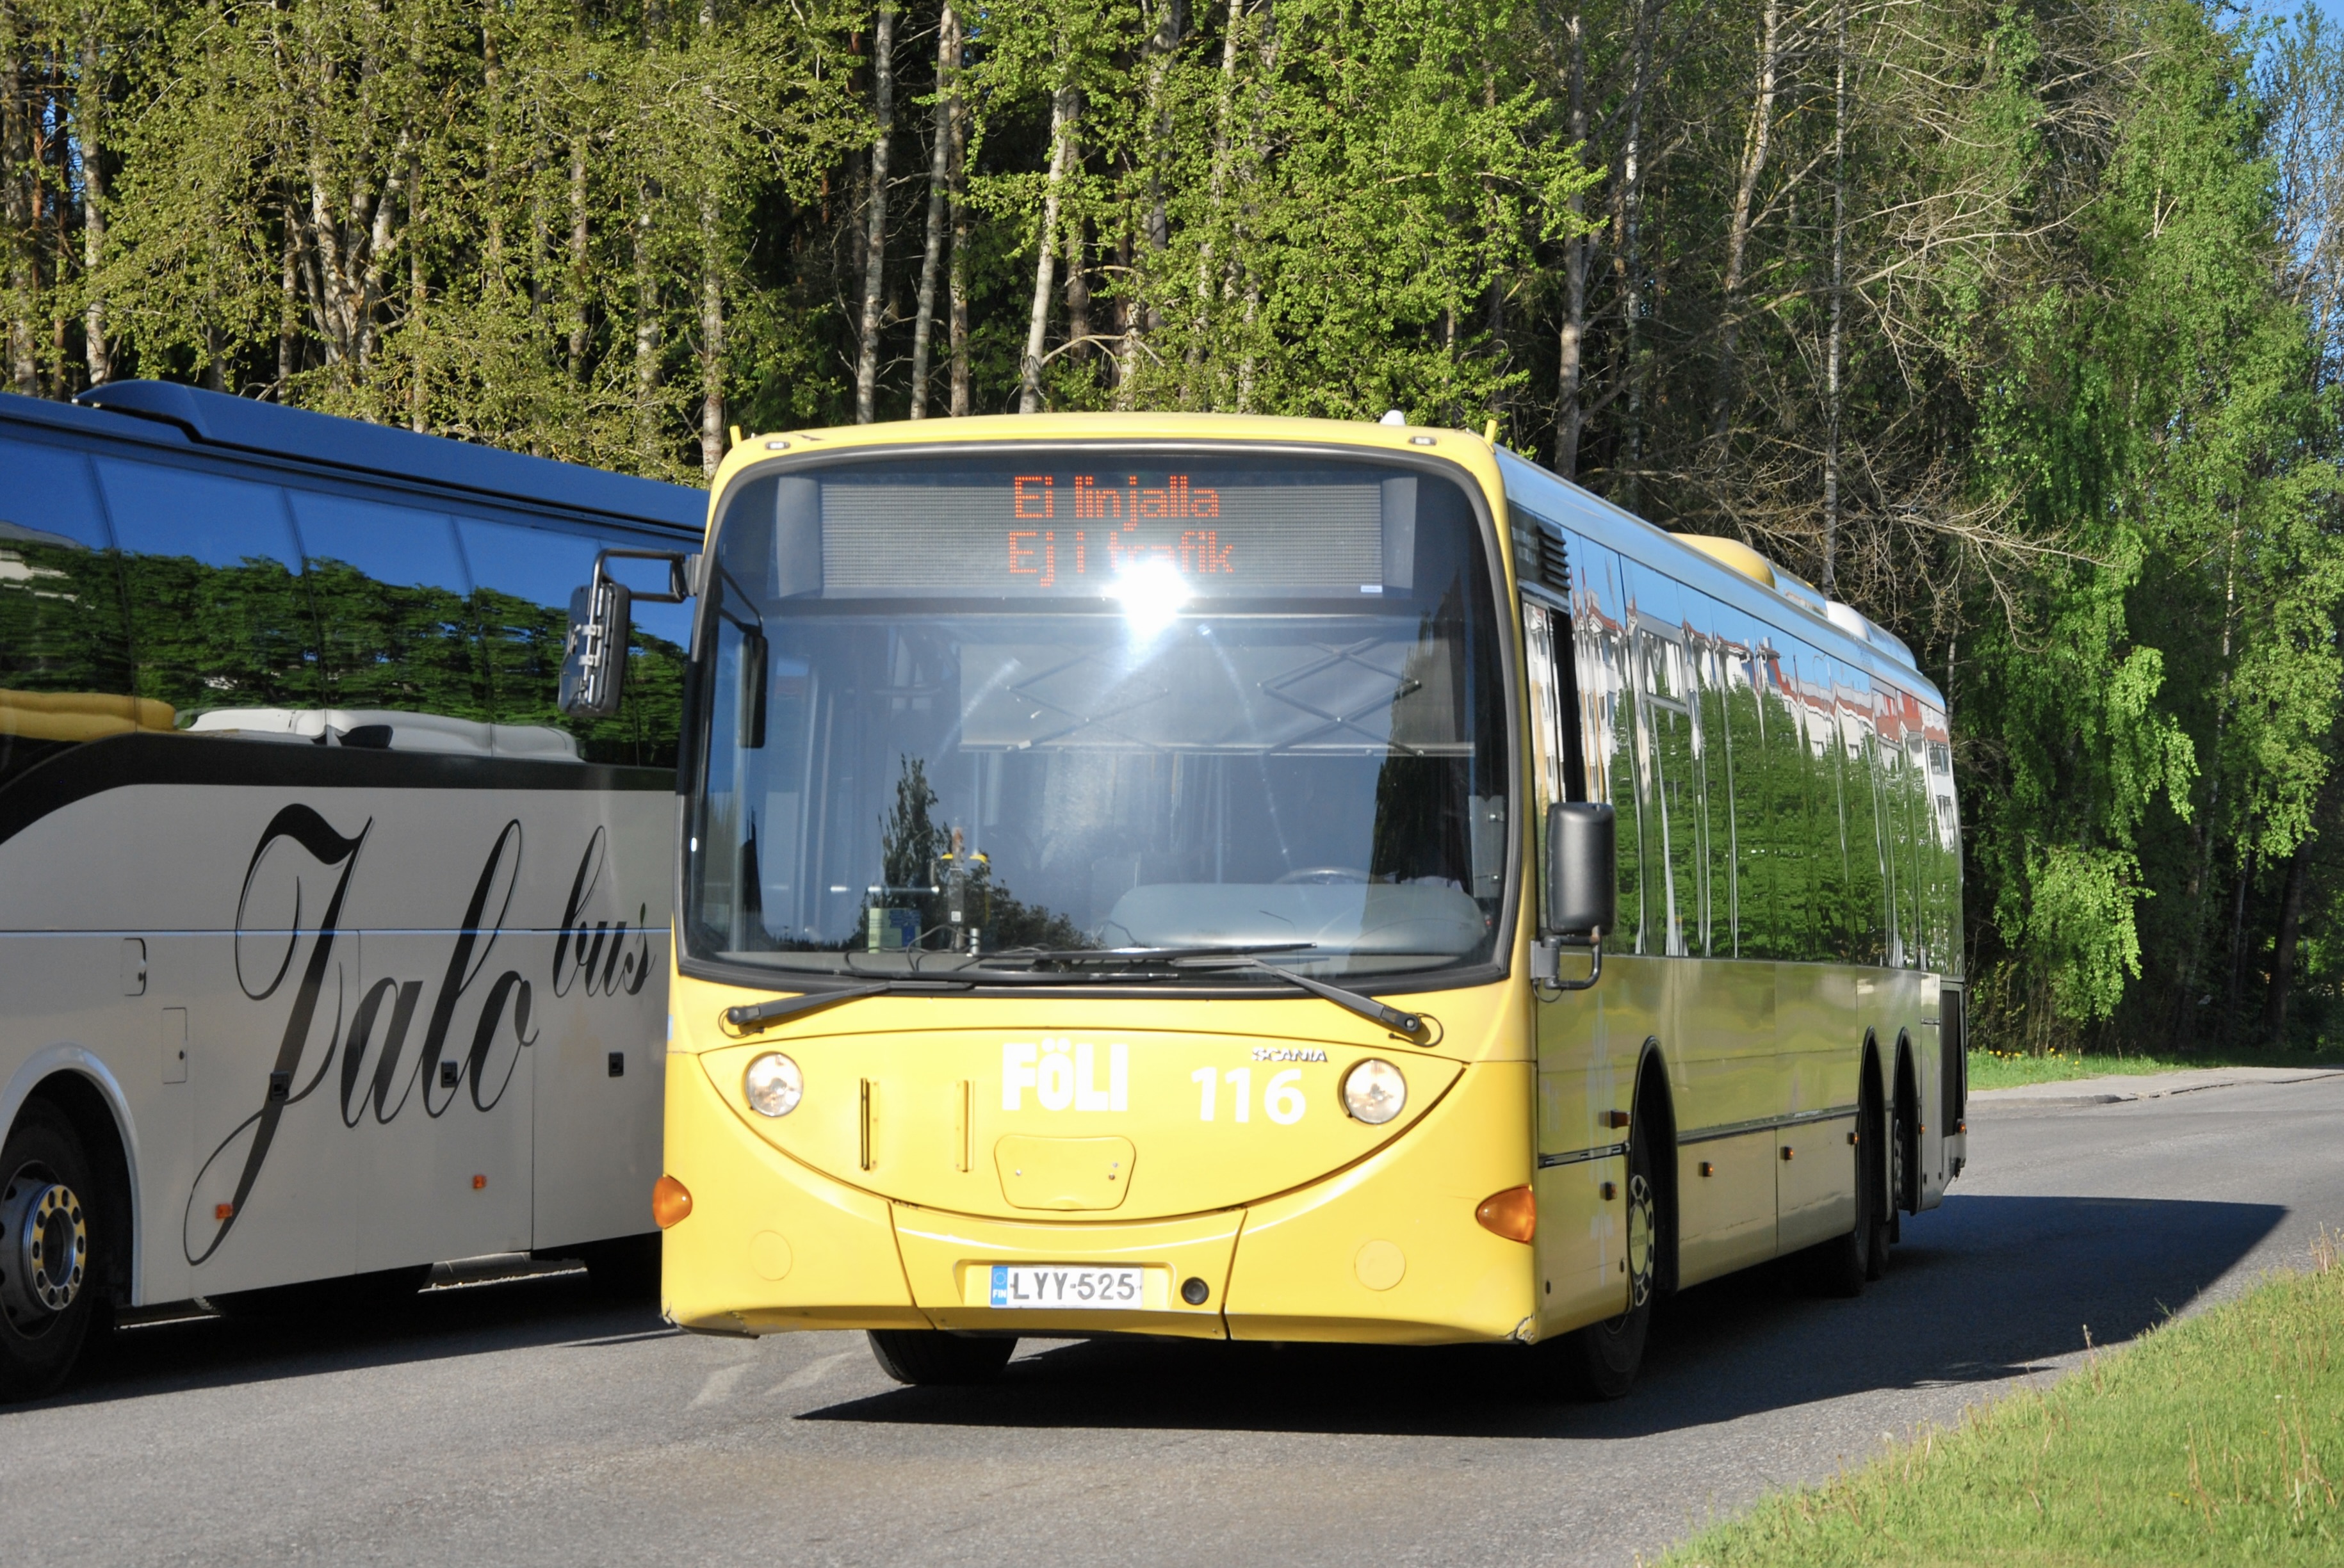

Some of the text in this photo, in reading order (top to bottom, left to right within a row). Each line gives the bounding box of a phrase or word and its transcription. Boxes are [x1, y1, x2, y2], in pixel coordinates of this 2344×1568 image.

[1015, 475, 1218, 531] Ei linjalla
[1009, 531, 1054, 587] Ej
[1077, 531, 1085, 573] i
[183, 803, 657, 1266] Jalo bus
[1251, 1047, 1328, 1063] SCANIA
[1191, 1066, 1306, 1125] 116
[993, 1289, 1007, 1298] FIN
[1013, 1272, 1135, 1300] LYY-525
